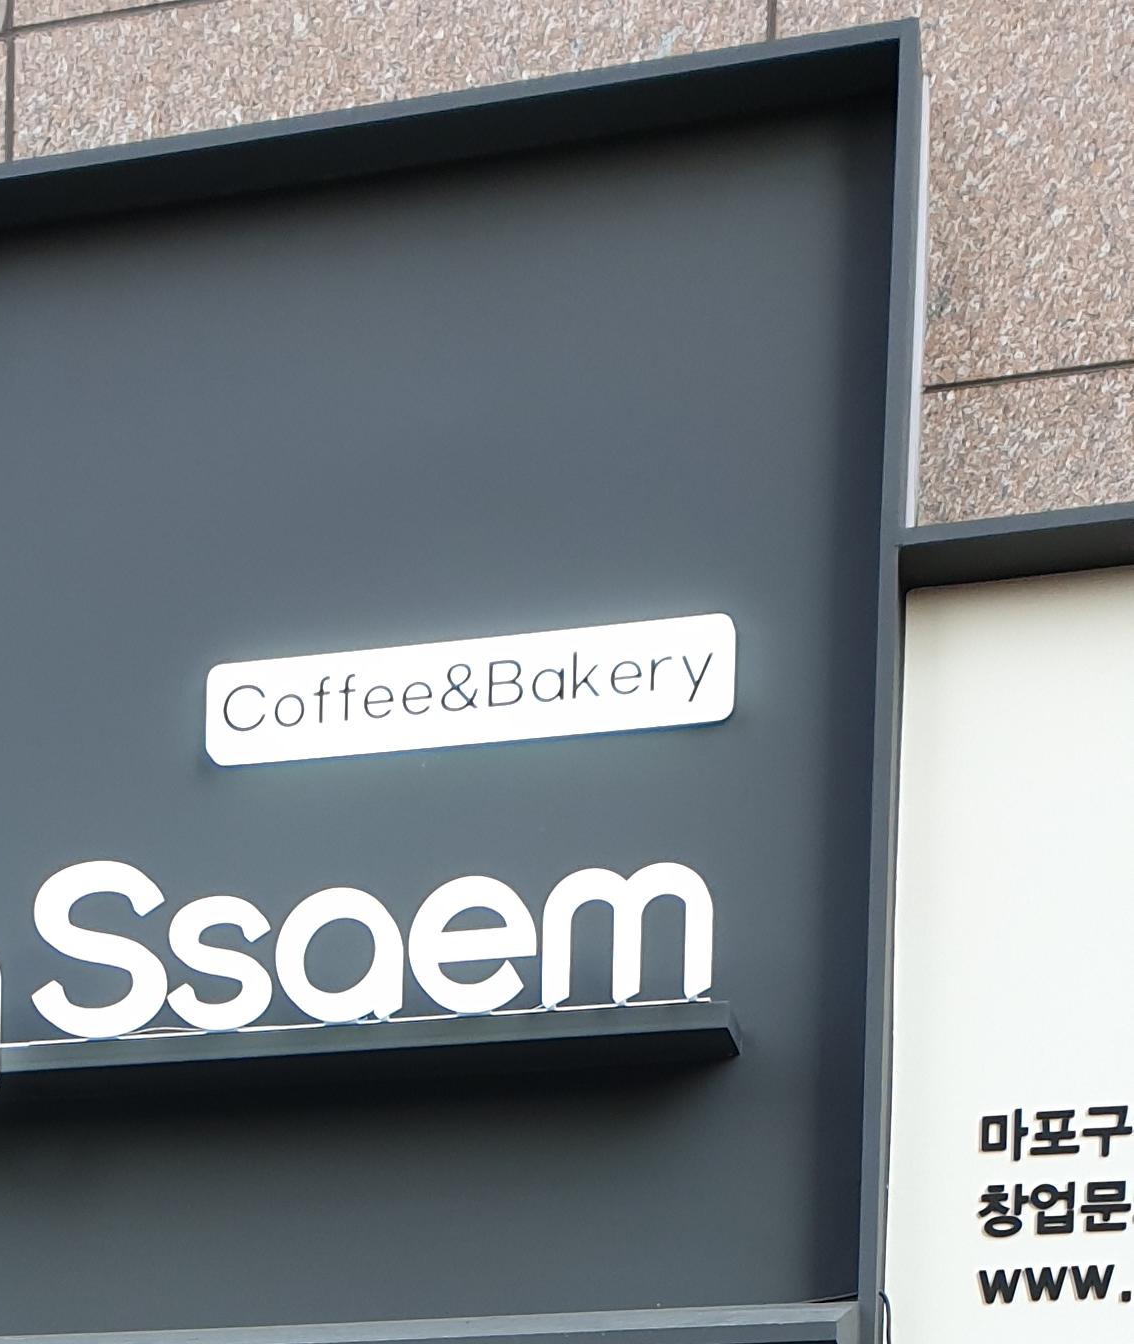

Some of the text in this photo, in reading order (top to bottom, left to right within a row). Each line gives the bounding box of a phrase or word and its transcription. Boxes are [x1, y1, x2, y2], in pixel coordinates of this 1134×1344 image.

[221, 646, 715, 733] Coffee&Bakery
[29, 856, 715, 1041] Ssaem
[978, 1105, 1133, 1161] 마포구
[978, 1264, 1132, 1305] www.
